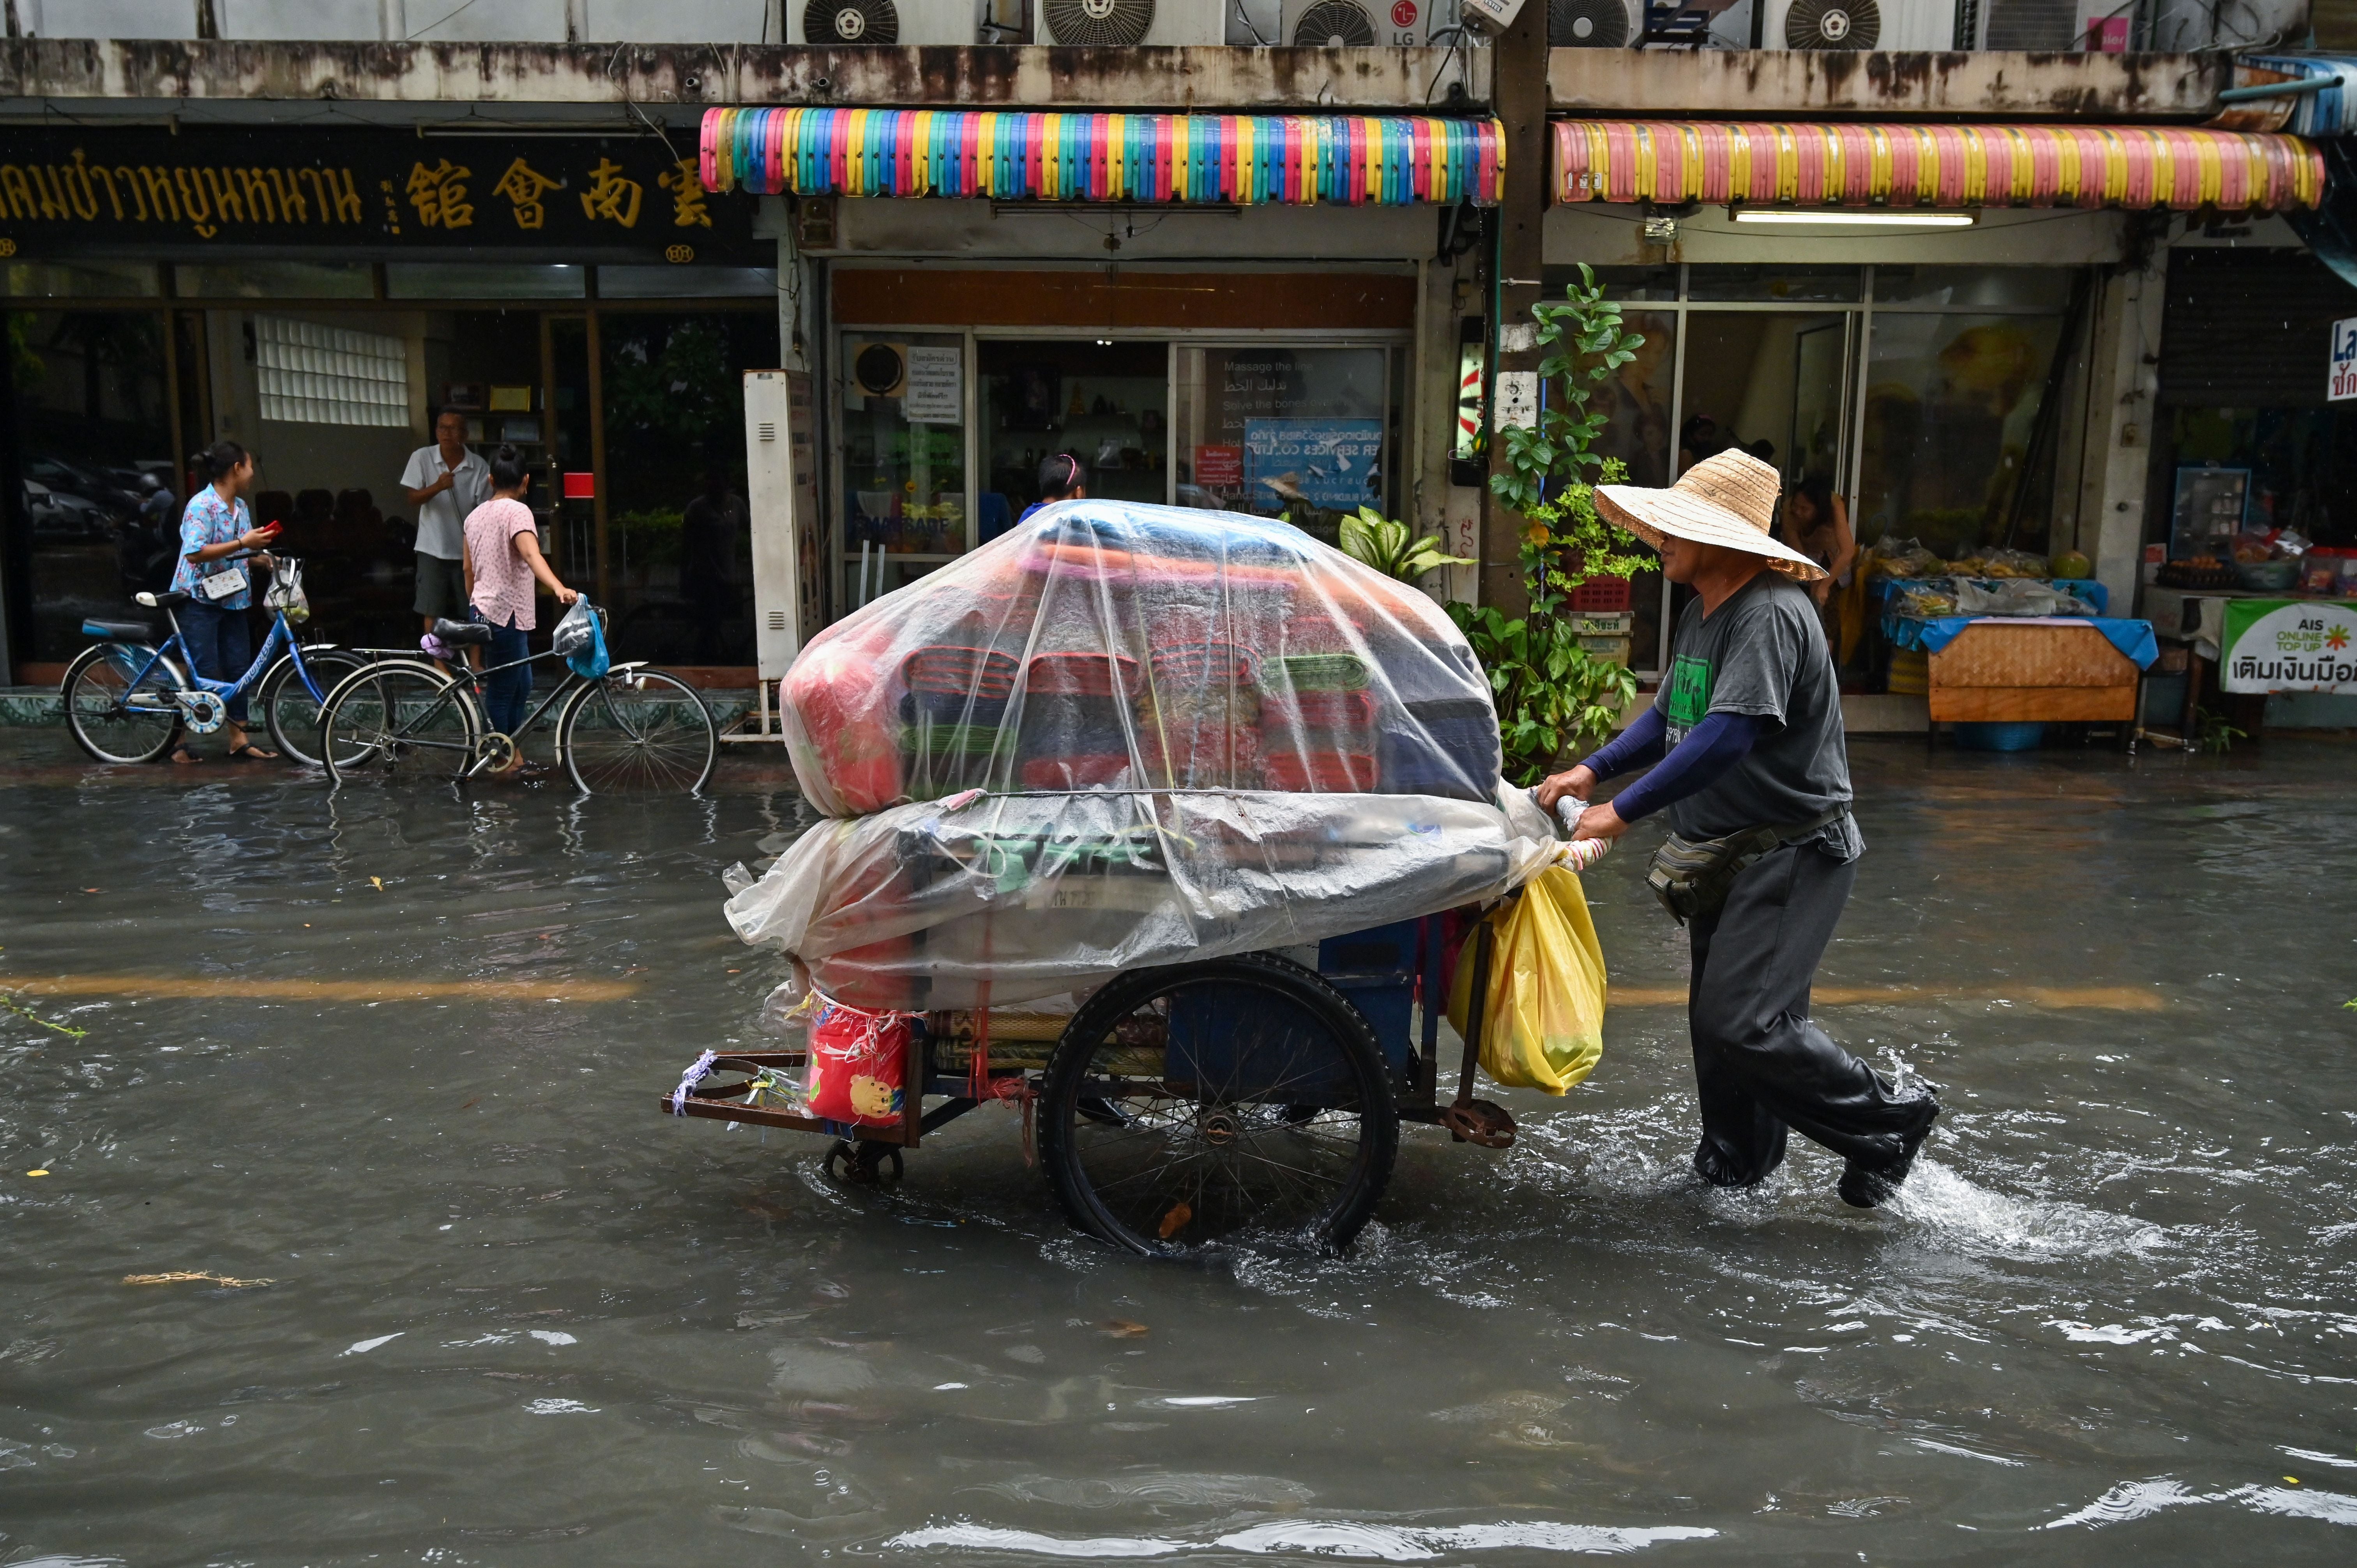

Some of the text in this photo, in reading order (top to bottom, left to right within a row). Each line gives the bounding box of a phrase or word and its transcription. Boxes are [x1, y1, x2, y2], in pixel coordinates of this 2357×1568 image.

[1393, 32, 1413, 46] LG
[1224, 361, 1313, 373] Massage the line
[1223, 400, 1253, 411] Solve
[1256, 397, 1272, 409] the
[1276, 397, 1306, 408] bones
[2298, 619, 2324, 631] AIS
[2276, 631, 2322, 642] ONLINE
[2276, 641, 2322, 652] TOP UP
[241, 633, 274, 685] TURBO
[2233, 655, 2357, 682] เติมเงินมือ
